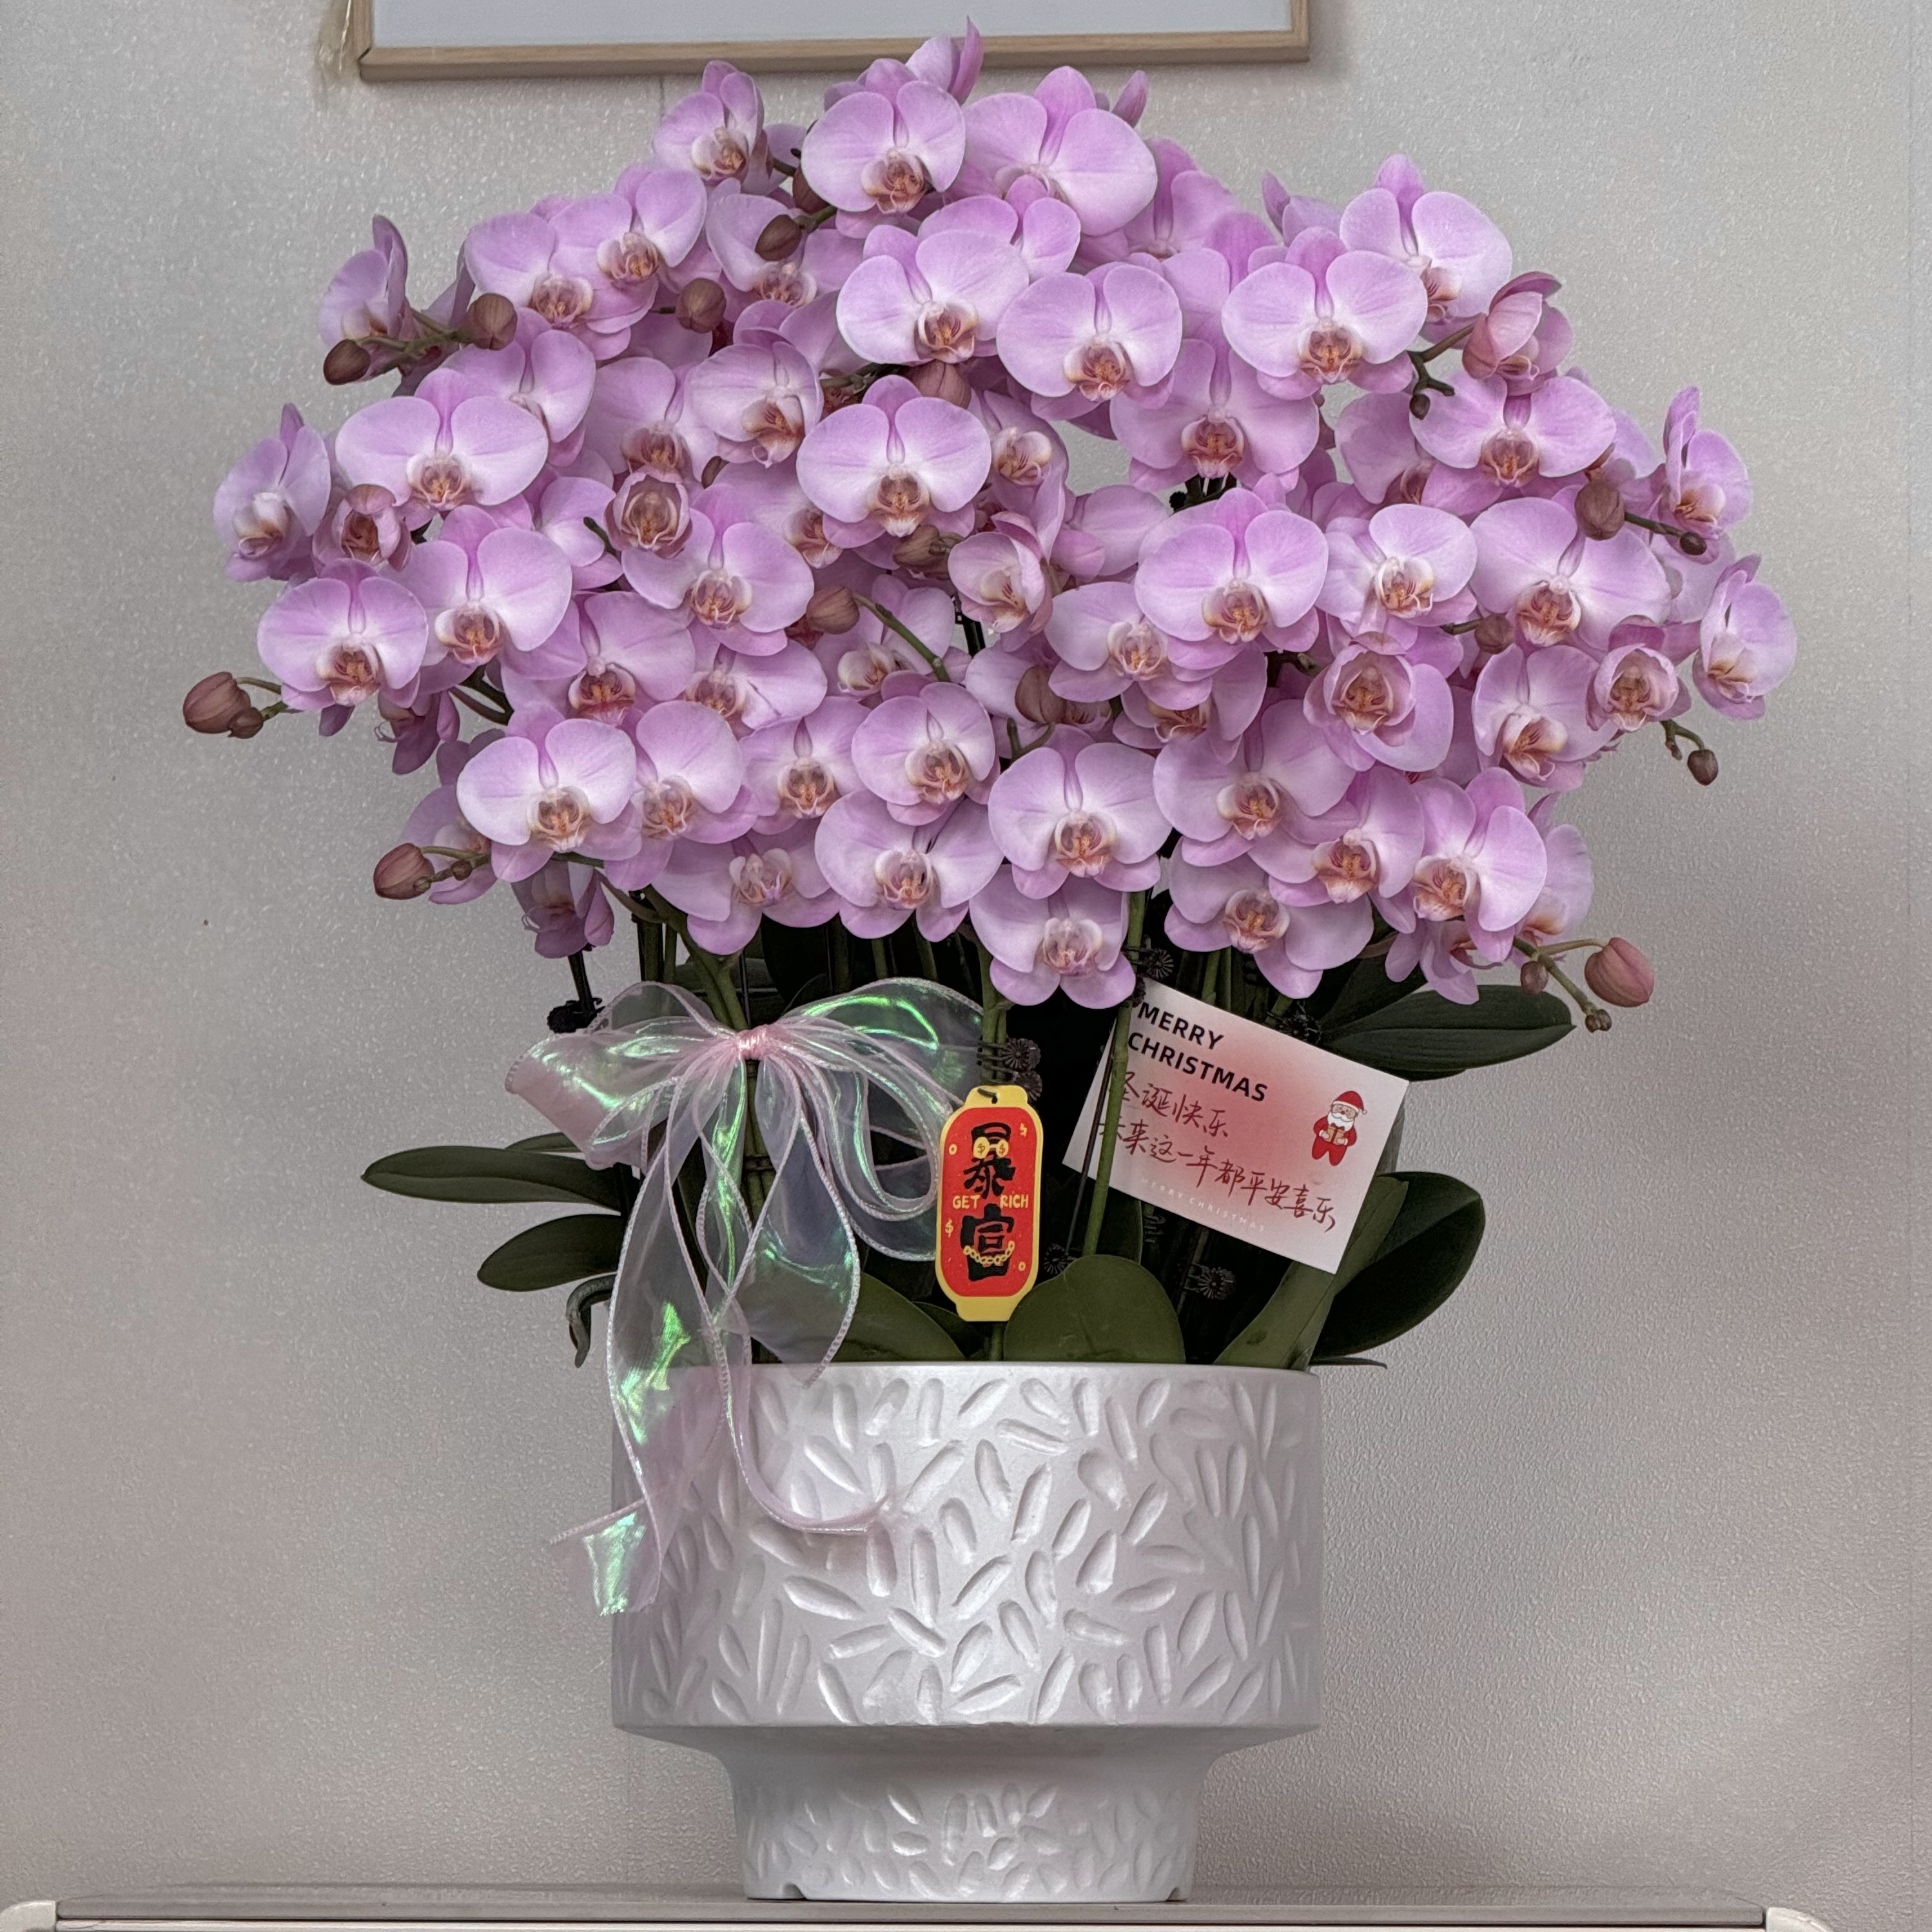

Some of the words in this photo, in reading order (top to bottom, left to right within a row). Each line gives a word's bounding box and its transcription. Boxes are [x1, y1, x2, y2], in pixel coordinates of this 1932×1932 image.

[1137, 1001, 1224, 1049] MERRY
[1127, 1031, 1267, 1102] CHRISTMAS
[952, 1194, 981, 1209] GET
[1000, 1194, 1029, 1209] RICH
[1189, 1197, 1265, 1233] CHRISTMAS
